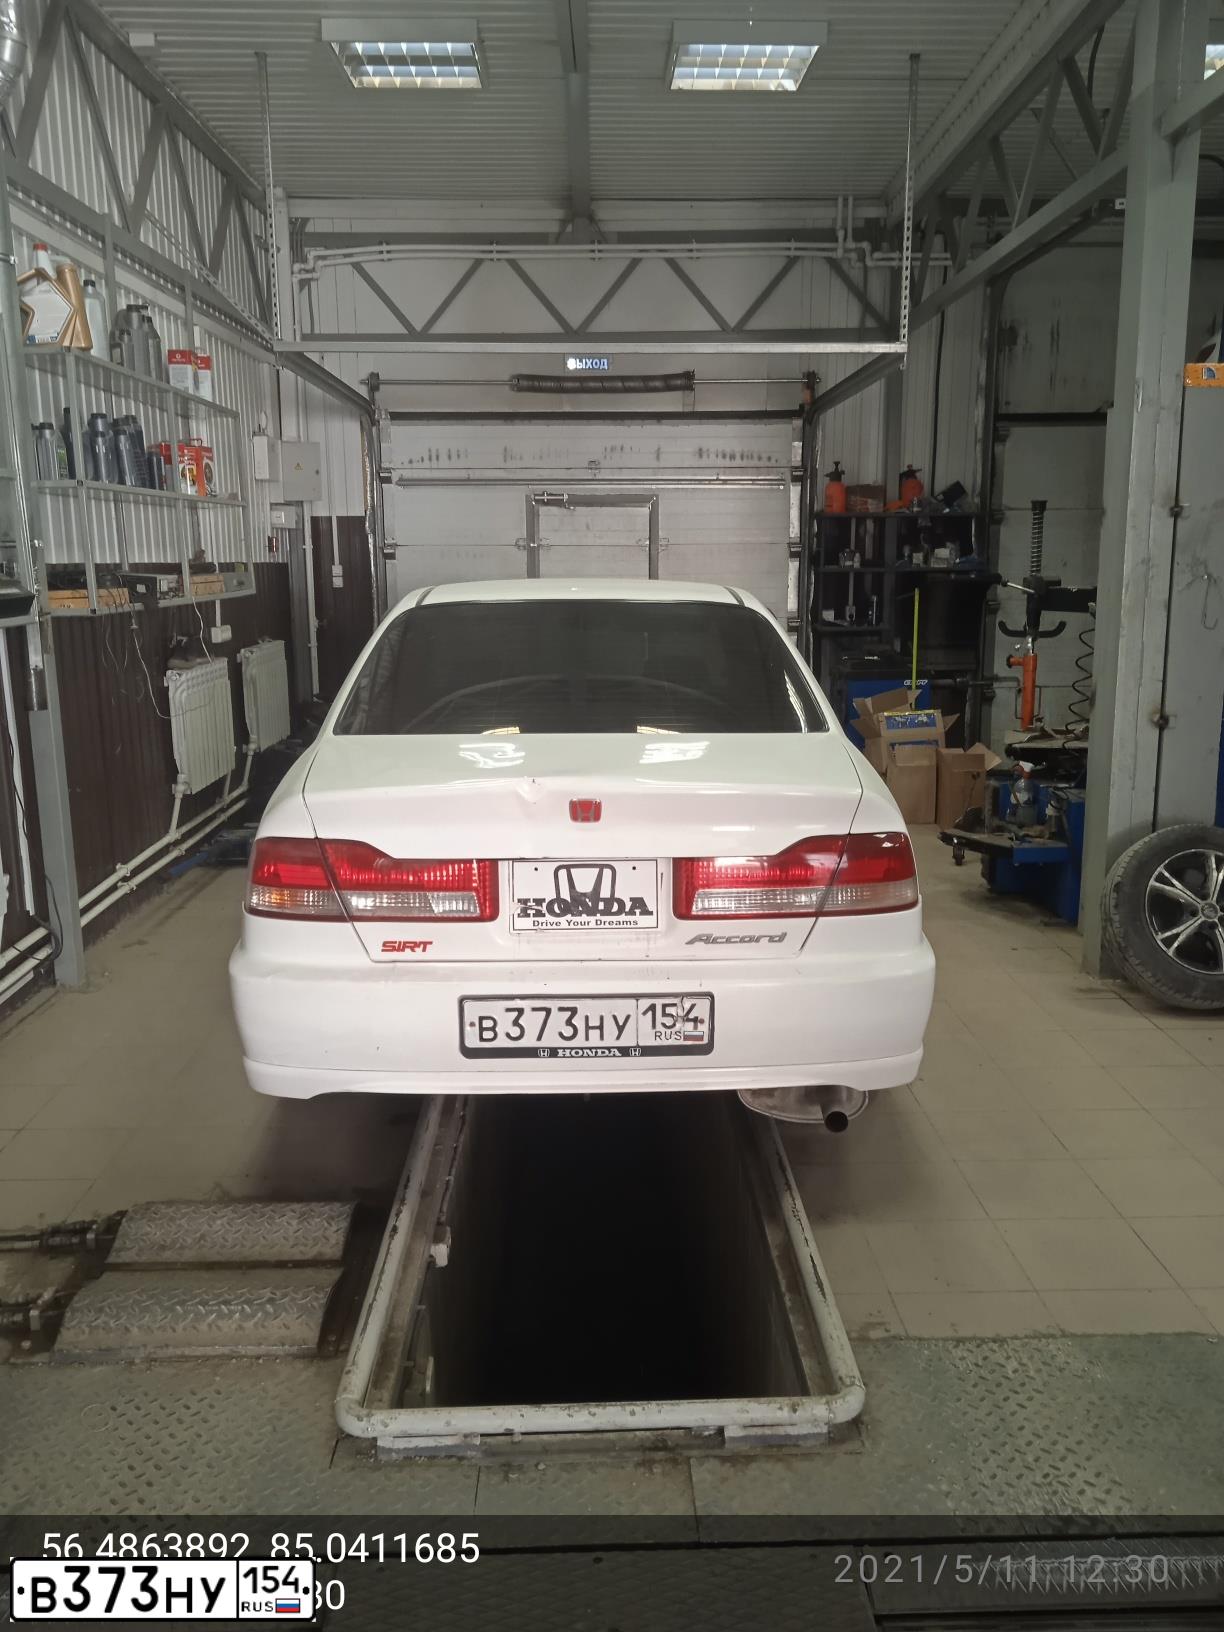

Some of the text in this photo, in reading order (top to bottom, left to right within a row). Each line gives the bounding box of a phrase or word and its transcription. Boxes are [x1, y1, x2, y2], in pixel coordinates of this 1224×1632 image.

[517, 897, 653, 918] HONDA
[566, 919, 591, 927] Your
[595, 918, 638, 926] Dreams
[685, 932, 787, 944] Accord
[641, 1002, 699, 1030] 154
[654, 1030, 682, 1041] RUS
[557, 1048, 622, 1057] HONDA
